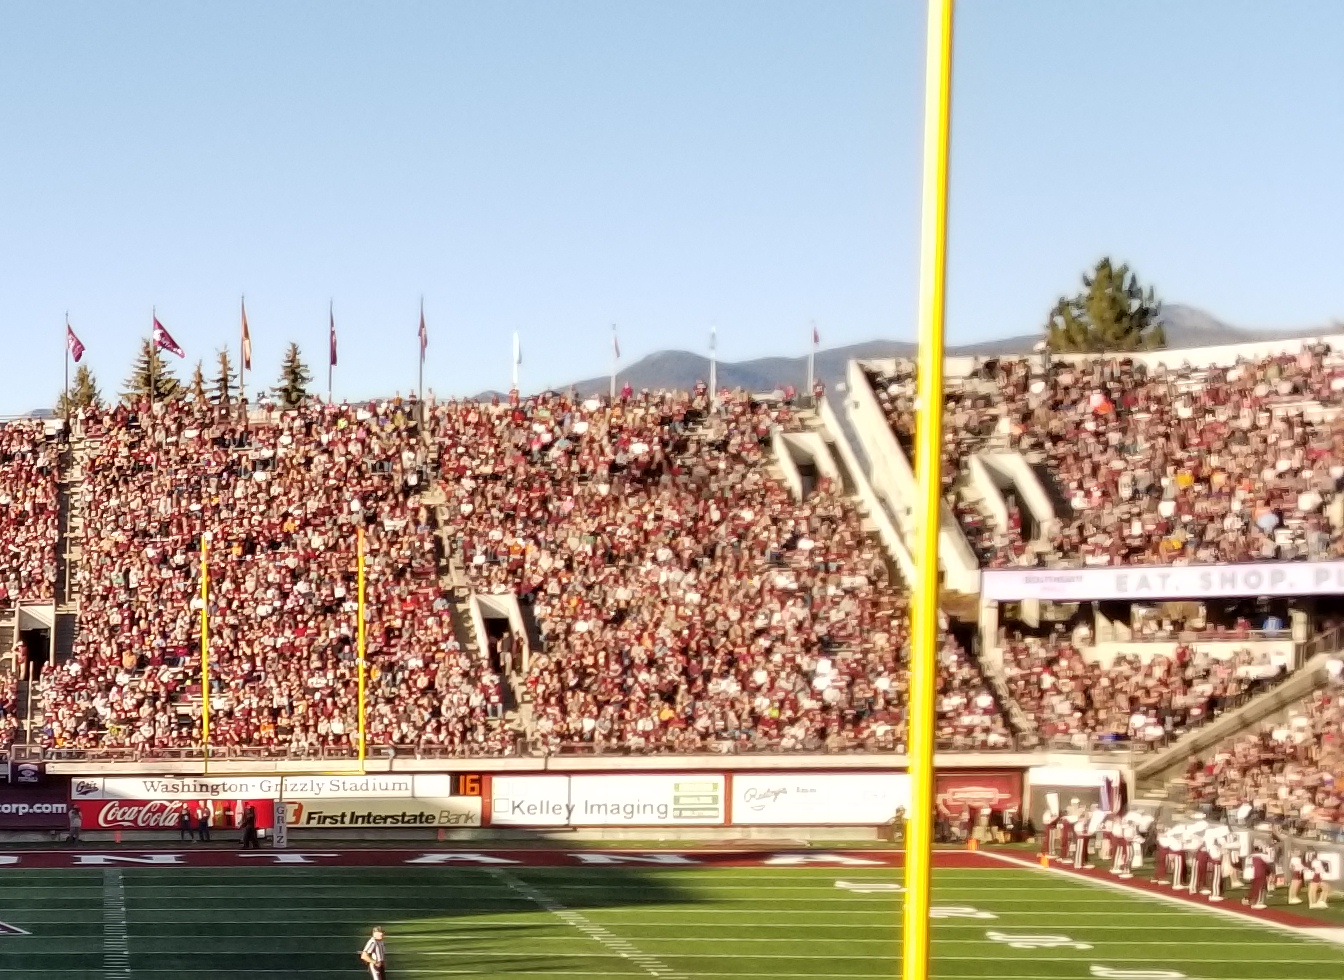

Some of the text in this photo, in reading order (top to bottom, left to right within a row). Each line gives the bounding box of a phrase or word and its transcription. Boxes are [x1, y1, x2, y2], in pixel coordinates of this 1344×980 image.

[329, 779, 410, 792] Stadium
[460, 775, 480, 796] 16
[98, 801, 182, 828] Coca-Cola
[305, 810, 476, 825] First Interstate Bank
[512, 800, 575, 820] Kelley
[584, 800, 669, 820] Imaging
[276, 806, 286, 844] GRIZ
